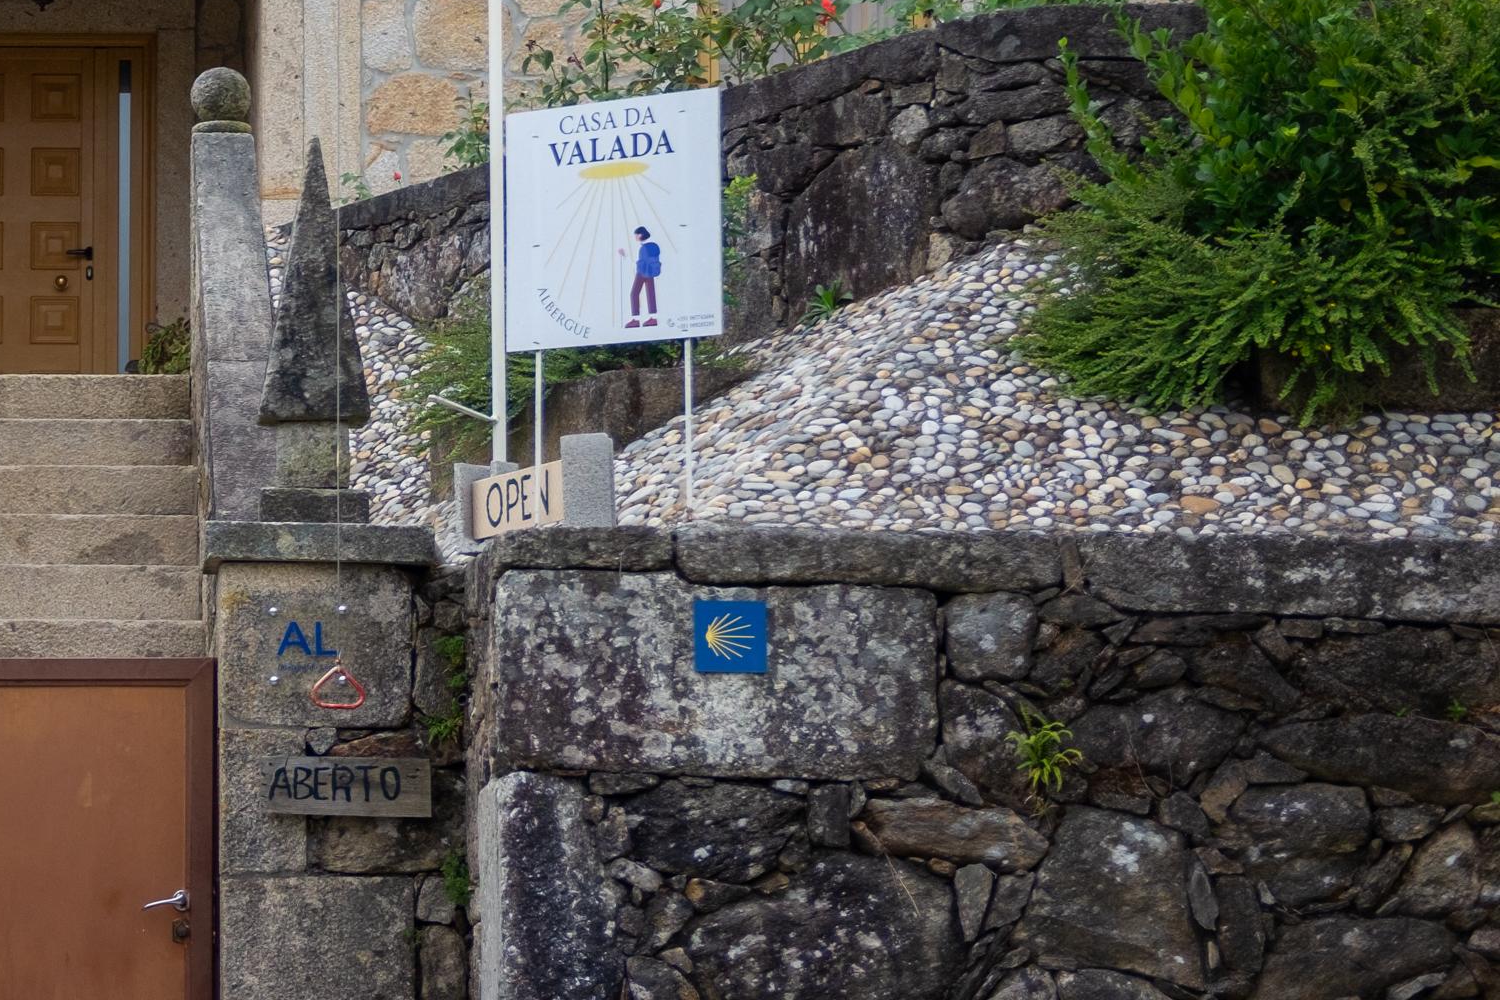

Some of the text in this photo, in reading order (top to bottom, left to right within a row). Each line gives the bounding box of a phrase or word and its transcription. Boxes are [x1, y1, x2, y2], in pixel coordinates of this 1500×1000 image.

[559, 106, 657, 136] CASA DA
[548, 129, 676, 167] VALADA
[536, 287, 591, 339] ALBERGUE
[486, 469, 549, 528] OPEN
[277, 621, 338, 657] AL
[269, 765, 402, 802] ABERTO
